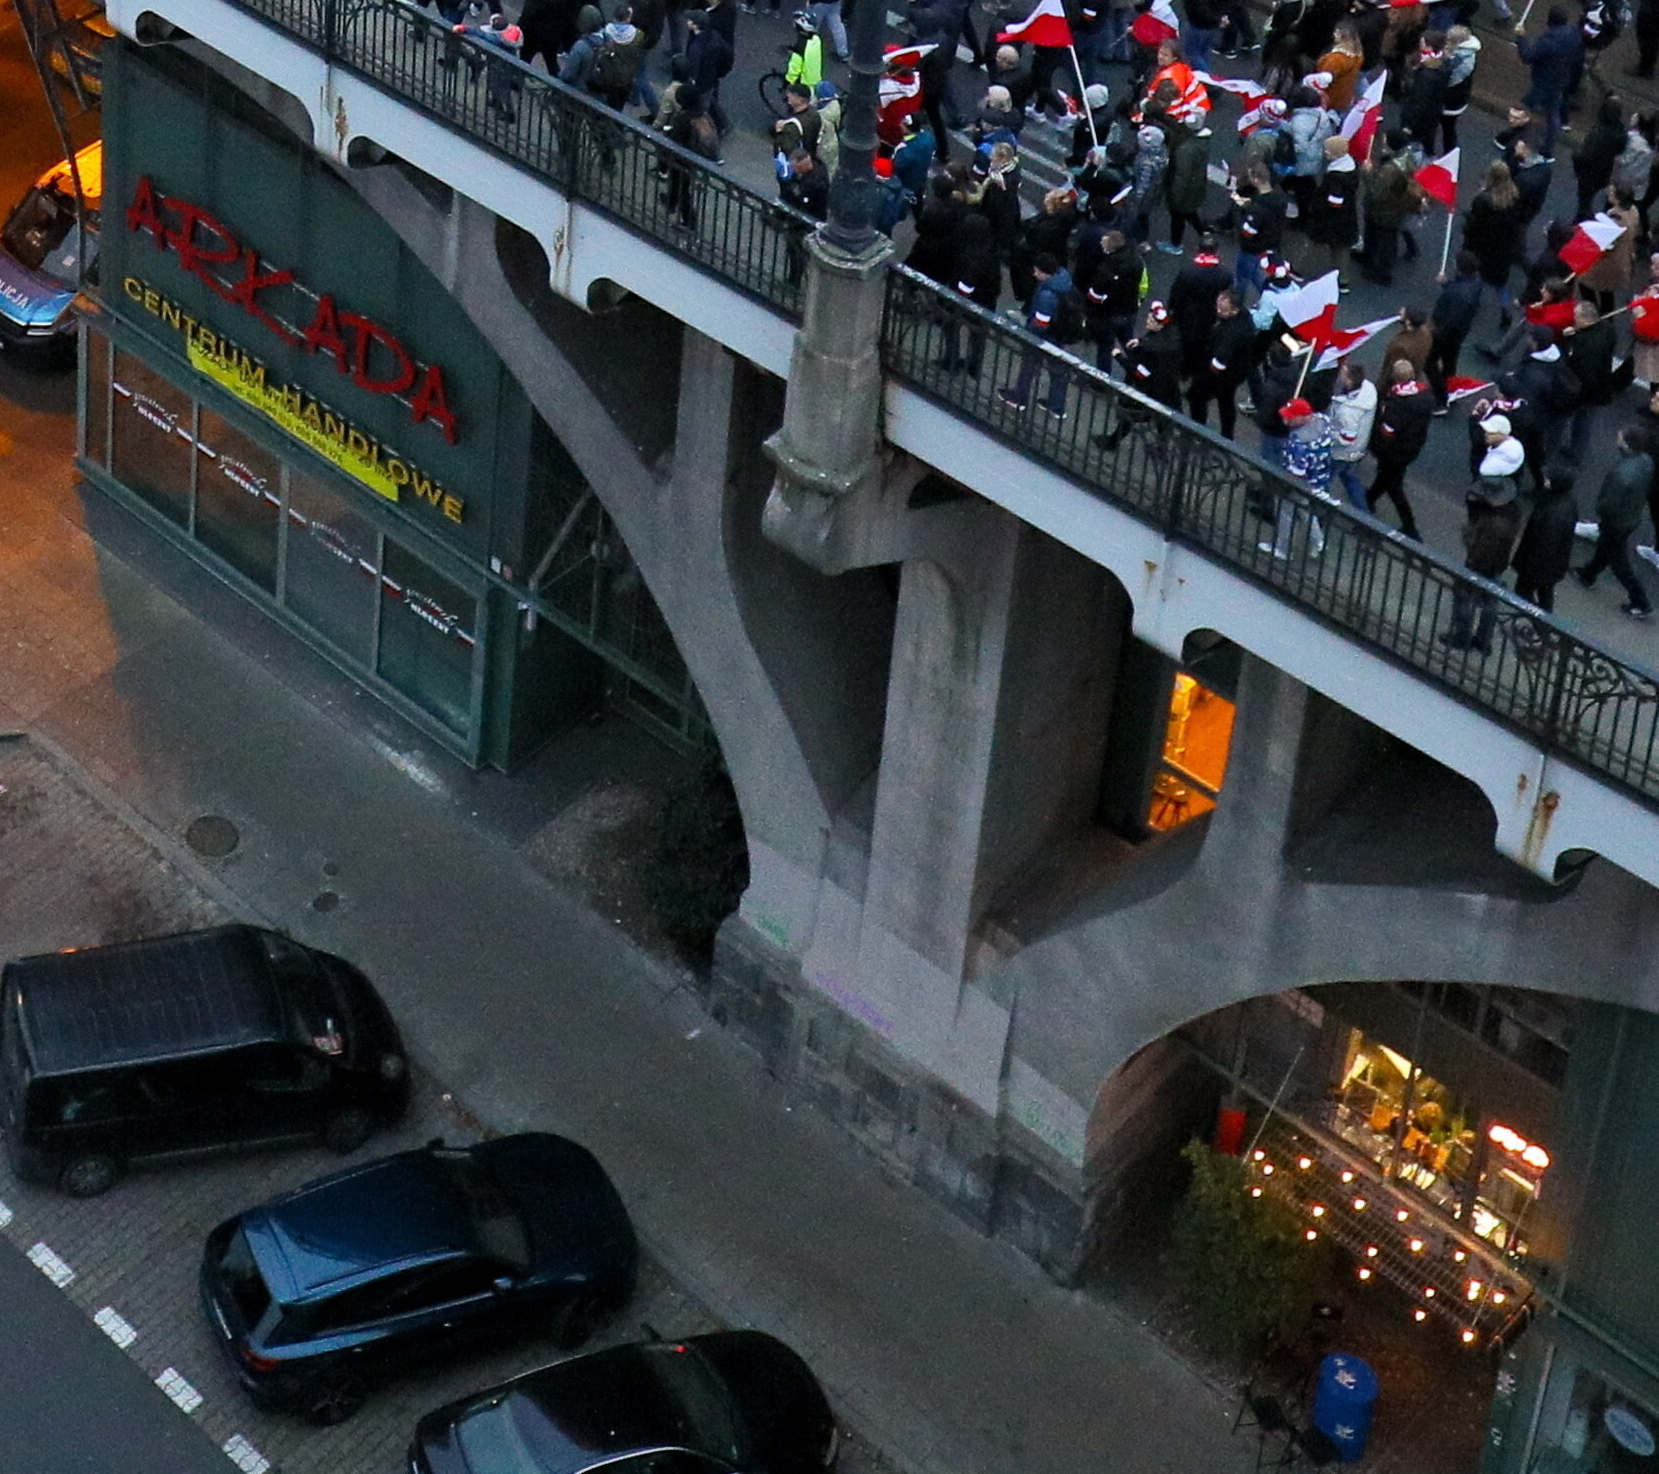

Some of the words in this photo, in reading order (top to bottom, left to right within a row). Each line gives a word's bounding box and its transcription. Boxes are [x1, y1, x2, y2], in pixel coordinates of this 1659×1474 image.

[122, 276, 266, 389] CENTRUM
[282, 382, 465, 524] HANDLOWE
[125, 176, 459, 447] ARKADA
